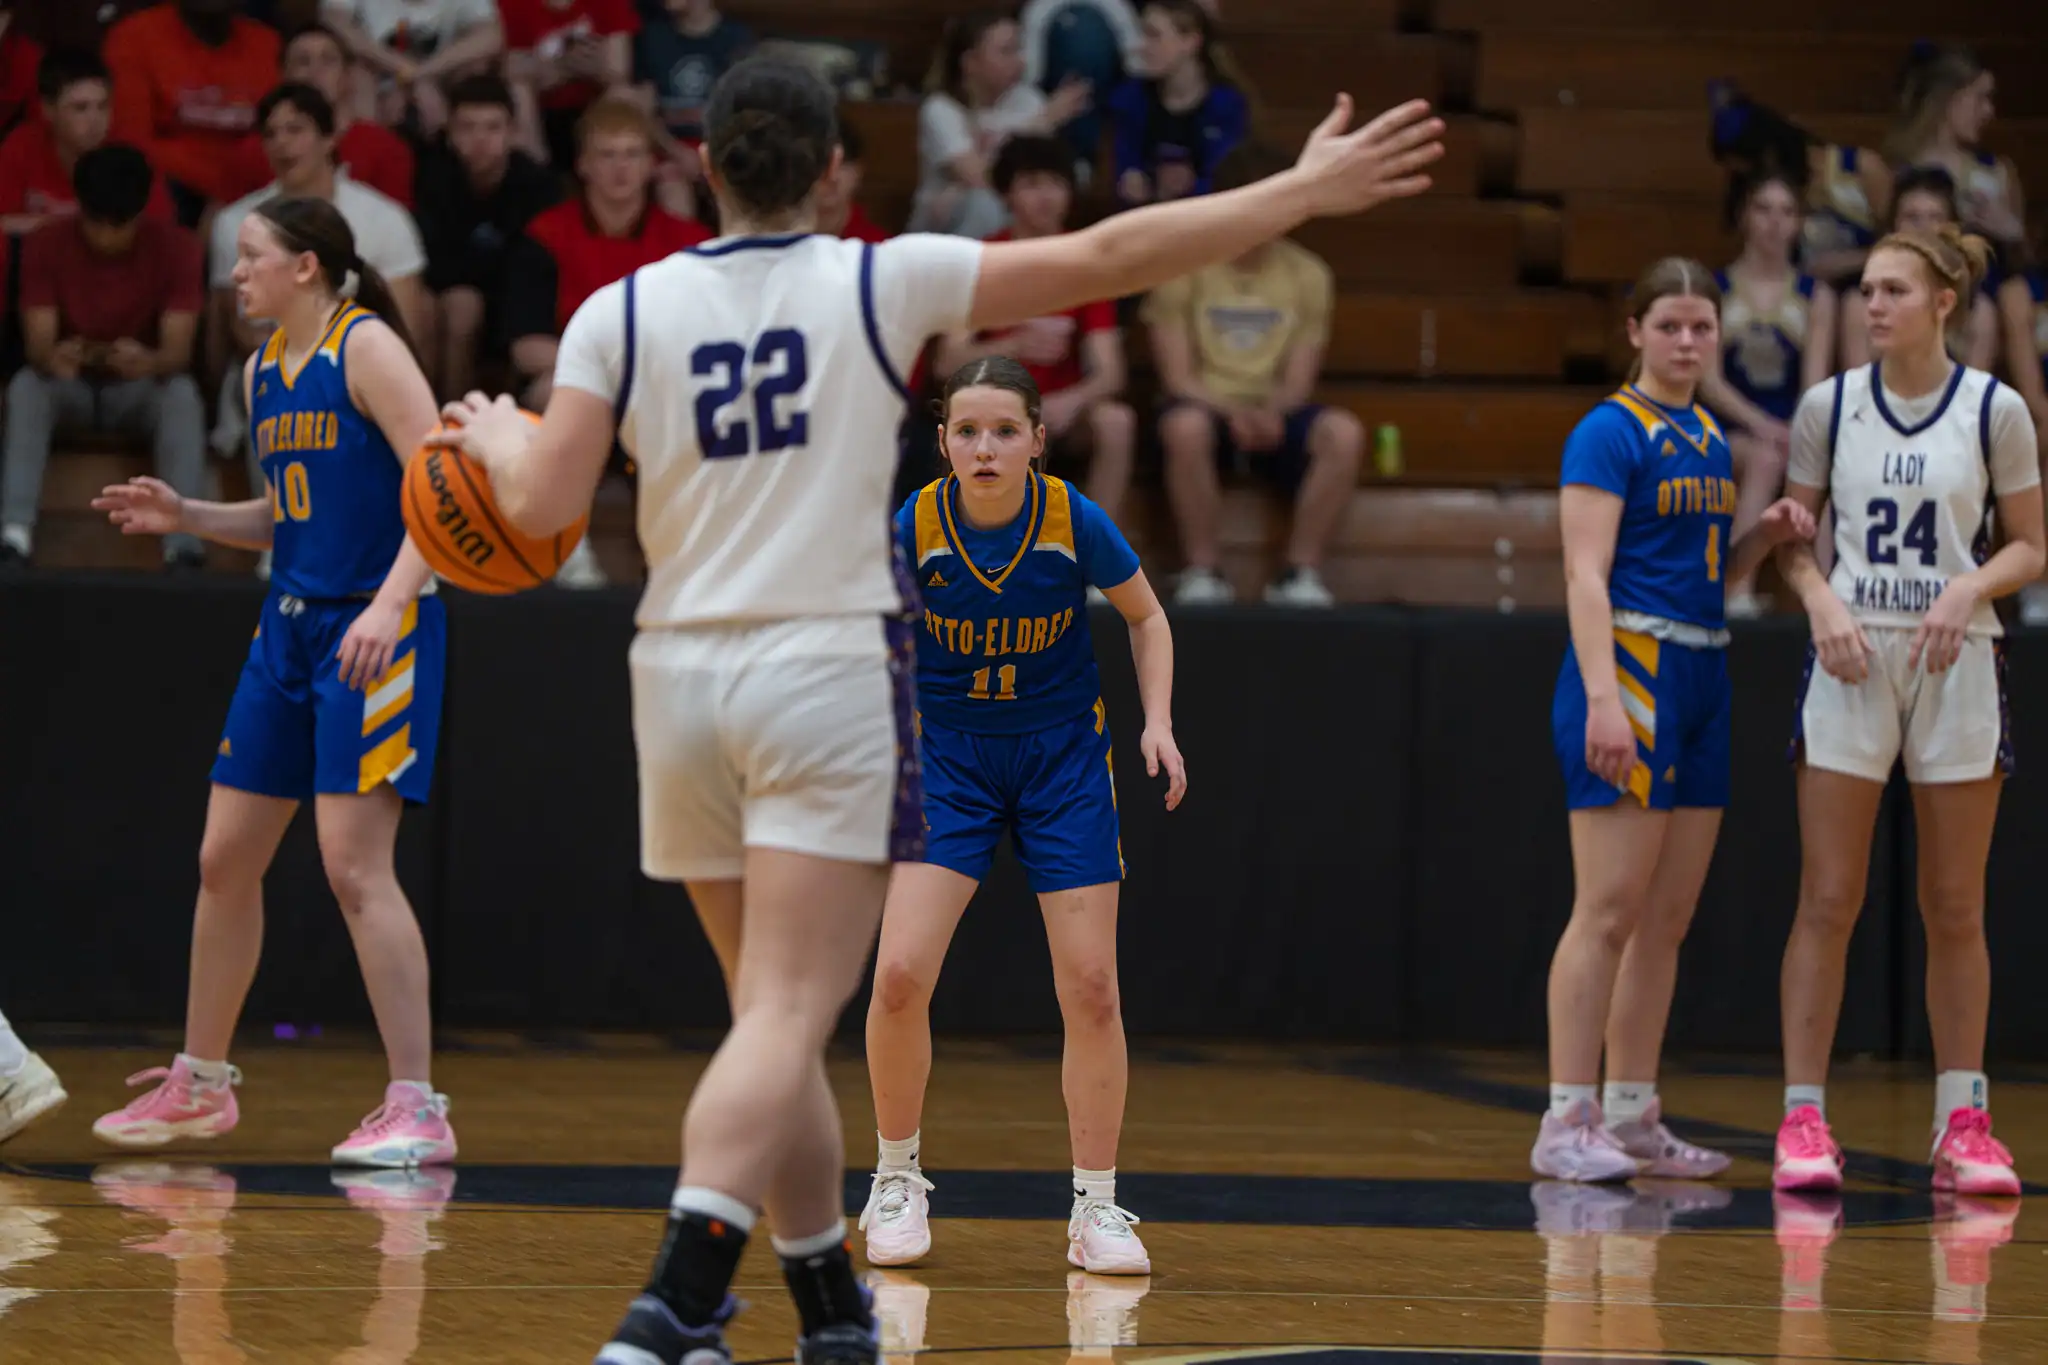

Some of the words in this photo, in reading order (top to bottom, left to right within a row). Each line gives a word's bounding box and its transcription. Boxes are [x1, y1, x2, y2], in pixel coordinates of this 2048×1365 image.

[691, 328, 807, 458] 22
[273, 462, 312, 522] 10
[1883, 452, 1927, 485] LADY
[1866, 497, 1938, 566] 24
[1853, 576, 1949, 612] MARAUDER
[967, 664, 1018, 700] 11
